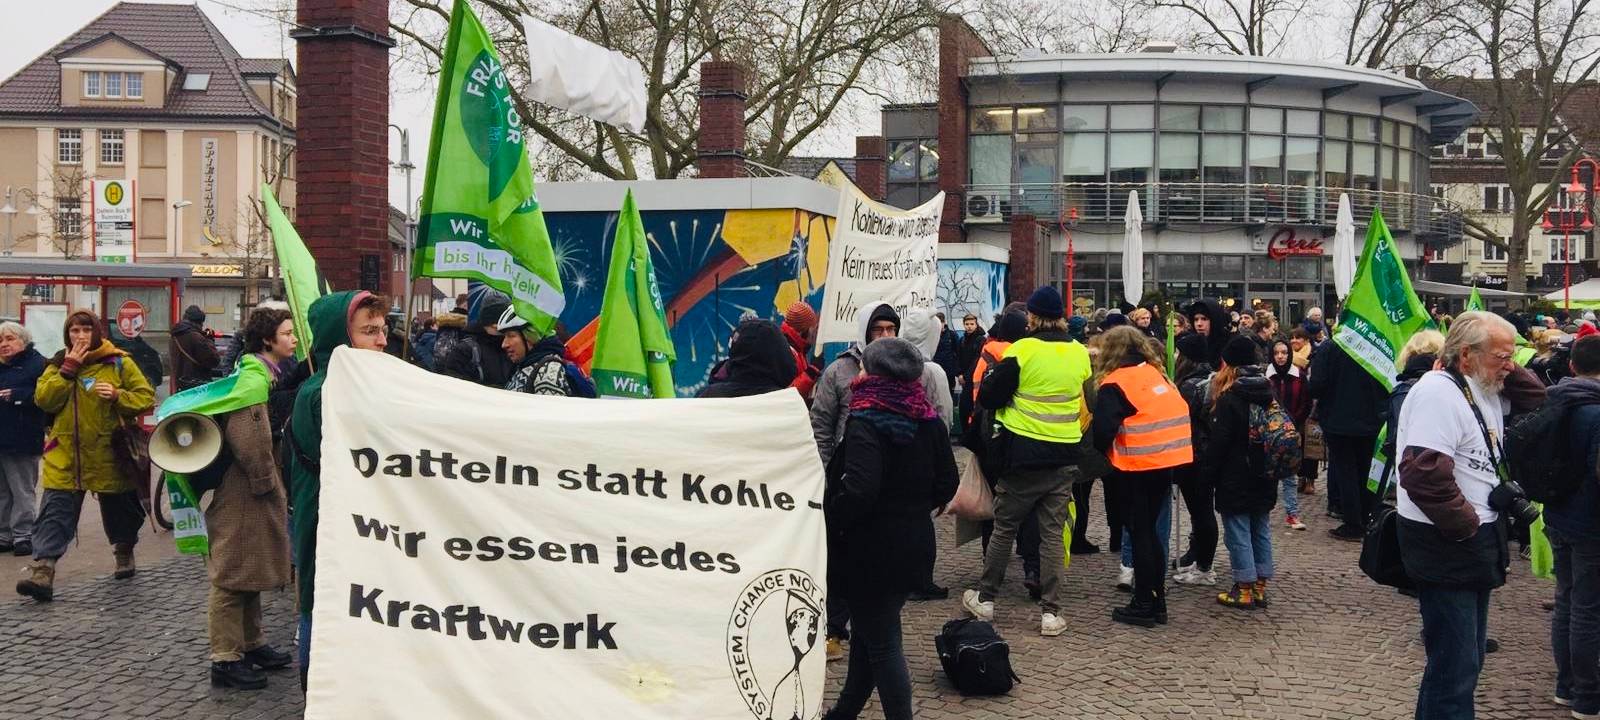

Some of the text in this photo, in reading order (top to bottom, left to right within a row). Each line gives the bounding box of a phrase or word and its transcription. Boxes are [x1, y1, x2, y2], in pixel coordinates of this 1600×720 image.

[450, 219, 483, 238] Wir
[443, 248, 469, 265] bis
[477, 251, 497, 272] Ihr
[841, 244, 865, 279] Kein
[835, 291, 858, 323] Wir
[613, 376, 640, 393] Wir
[350, 447, 539, 486] Datteln
[557, 463, 667, 499] statt
[682, 473, 795, 511] Kohle
[351, 513, 741, 574] wir essen jedes
[349, 583, 618, 650] Kraftwerk
[732, 573, 817, 715] SYSTEM CHANGE NOT
